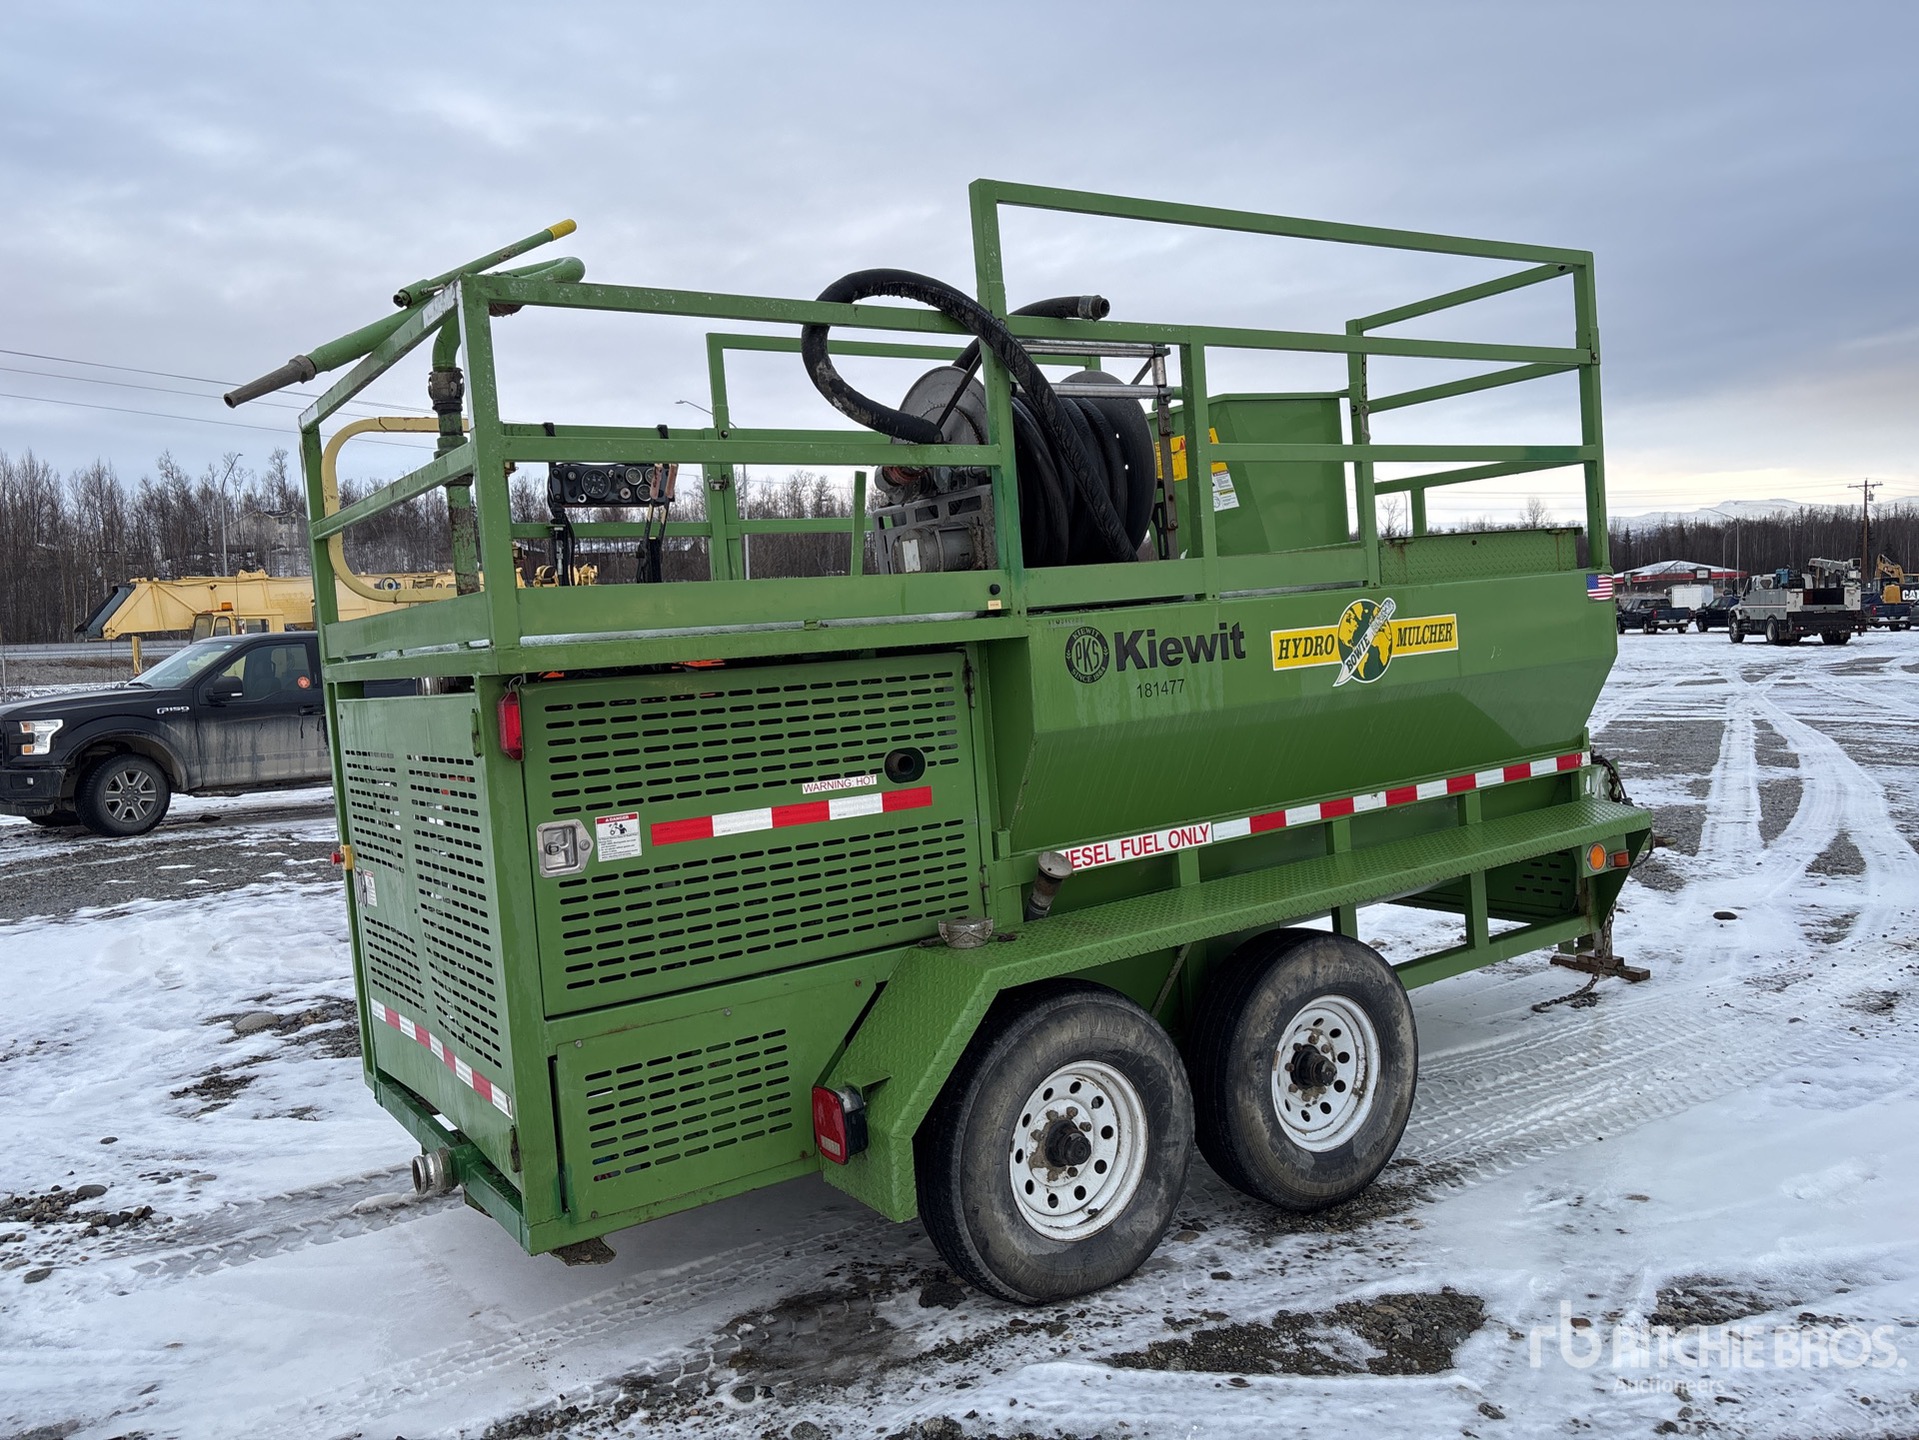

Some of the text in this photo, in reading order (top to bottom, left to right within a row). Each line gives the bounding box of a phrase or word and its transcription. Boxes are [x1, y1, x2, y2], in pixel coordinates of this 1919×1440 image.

[1072, 627, 1100, 641] KIEWIT
[1114, 621, 1246, 672] Kiewit
[1277, 622, 1453, 662] HYDRO MULCHER
[1075, 637, 1100, 673] PKS
[1345, 633, 1370, 674] BOWIE
[1071, 668, 1093, 683] SINCE
[1136, 678, 1185, 699] 181477
[856, 774, 876, 786] HOT
[1065, 824, 1210, 869] ESEL FUEL ONLY
